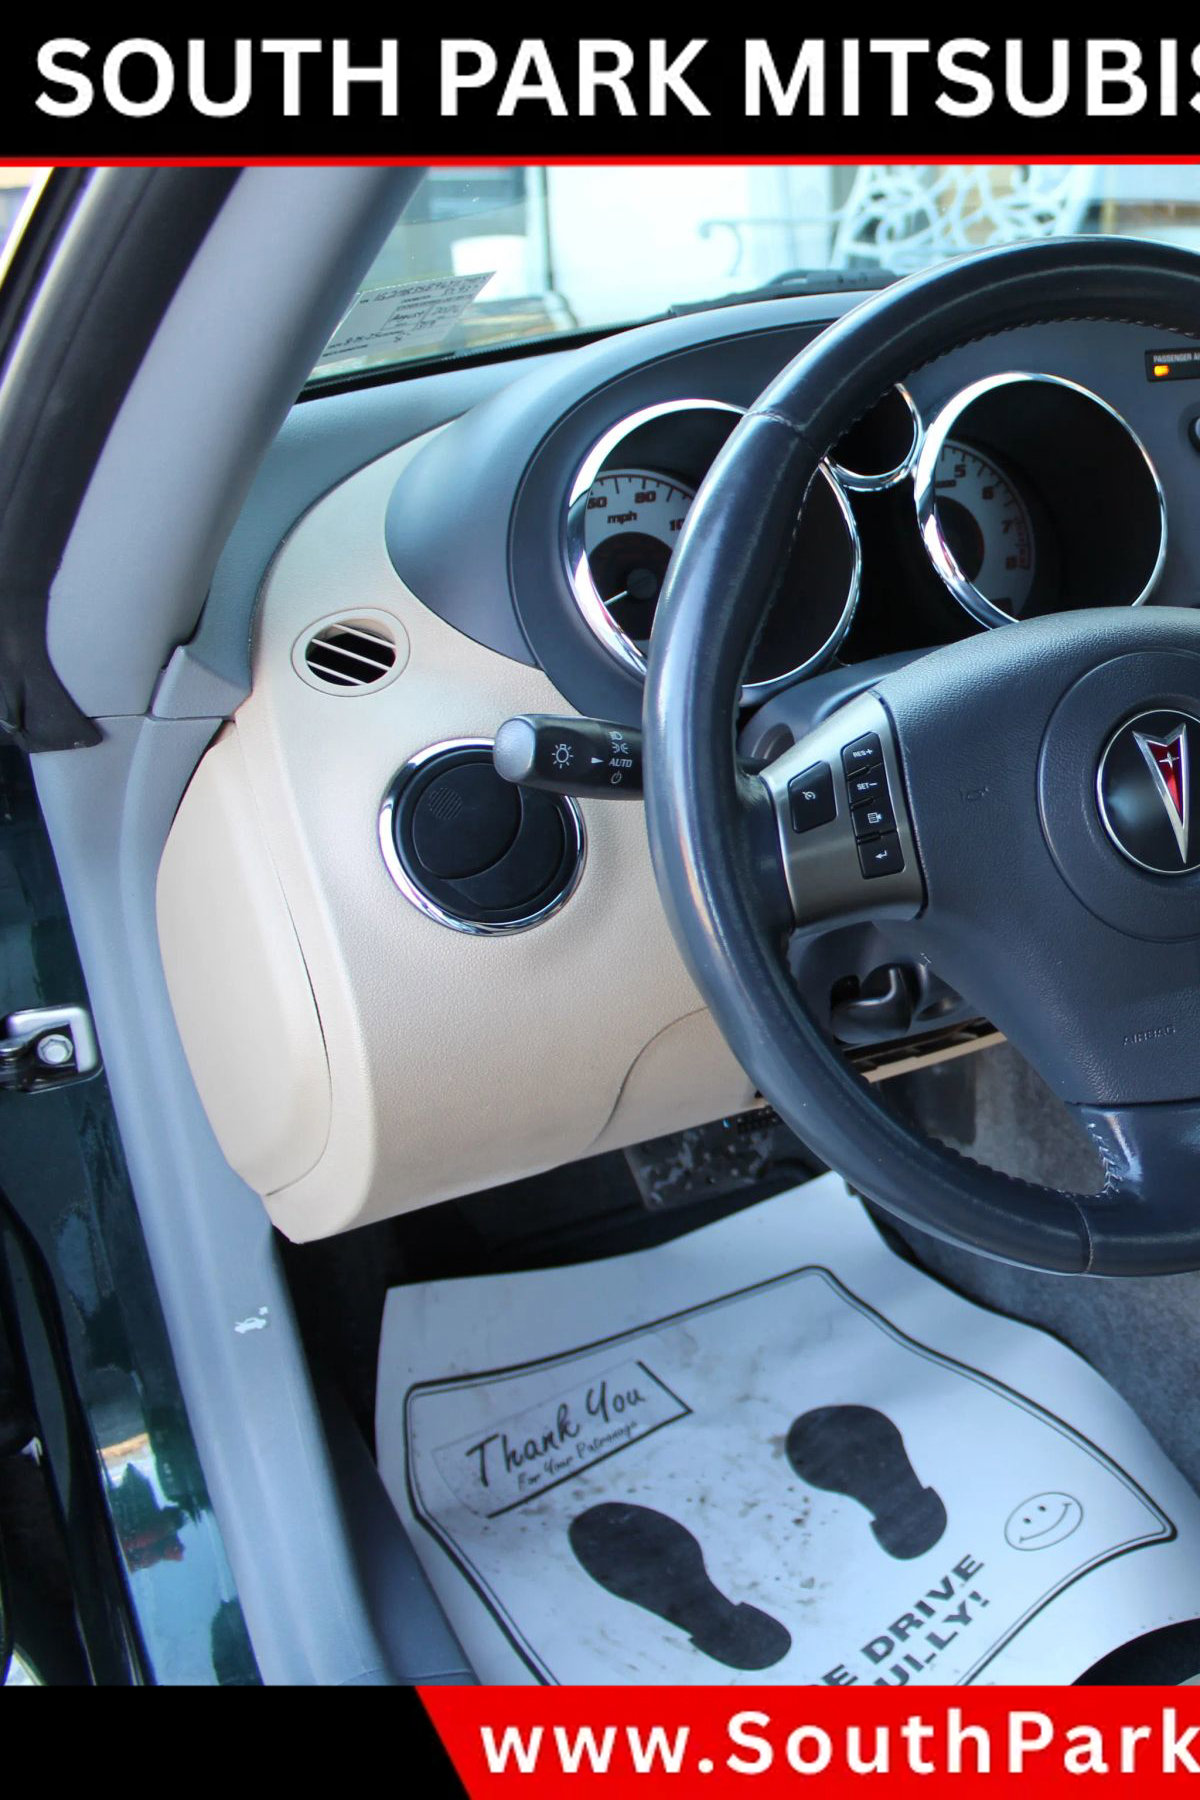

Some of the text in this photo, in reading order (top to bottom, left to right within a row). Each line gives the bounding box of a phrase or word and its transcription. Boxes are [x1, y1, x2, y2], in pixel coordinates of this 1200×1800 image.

[1153, 353, 1192, 362] PASSENGER
[607, 511, 638, 525] mph
[609, 758, 633, 768] AUTO
[465, 1380, 646, 1487] Thank You
[517, 1472, 541, 1491] For
[543, 1456, 573, 1475] Your
[861, 1553, 985, 1665] DRIVE
